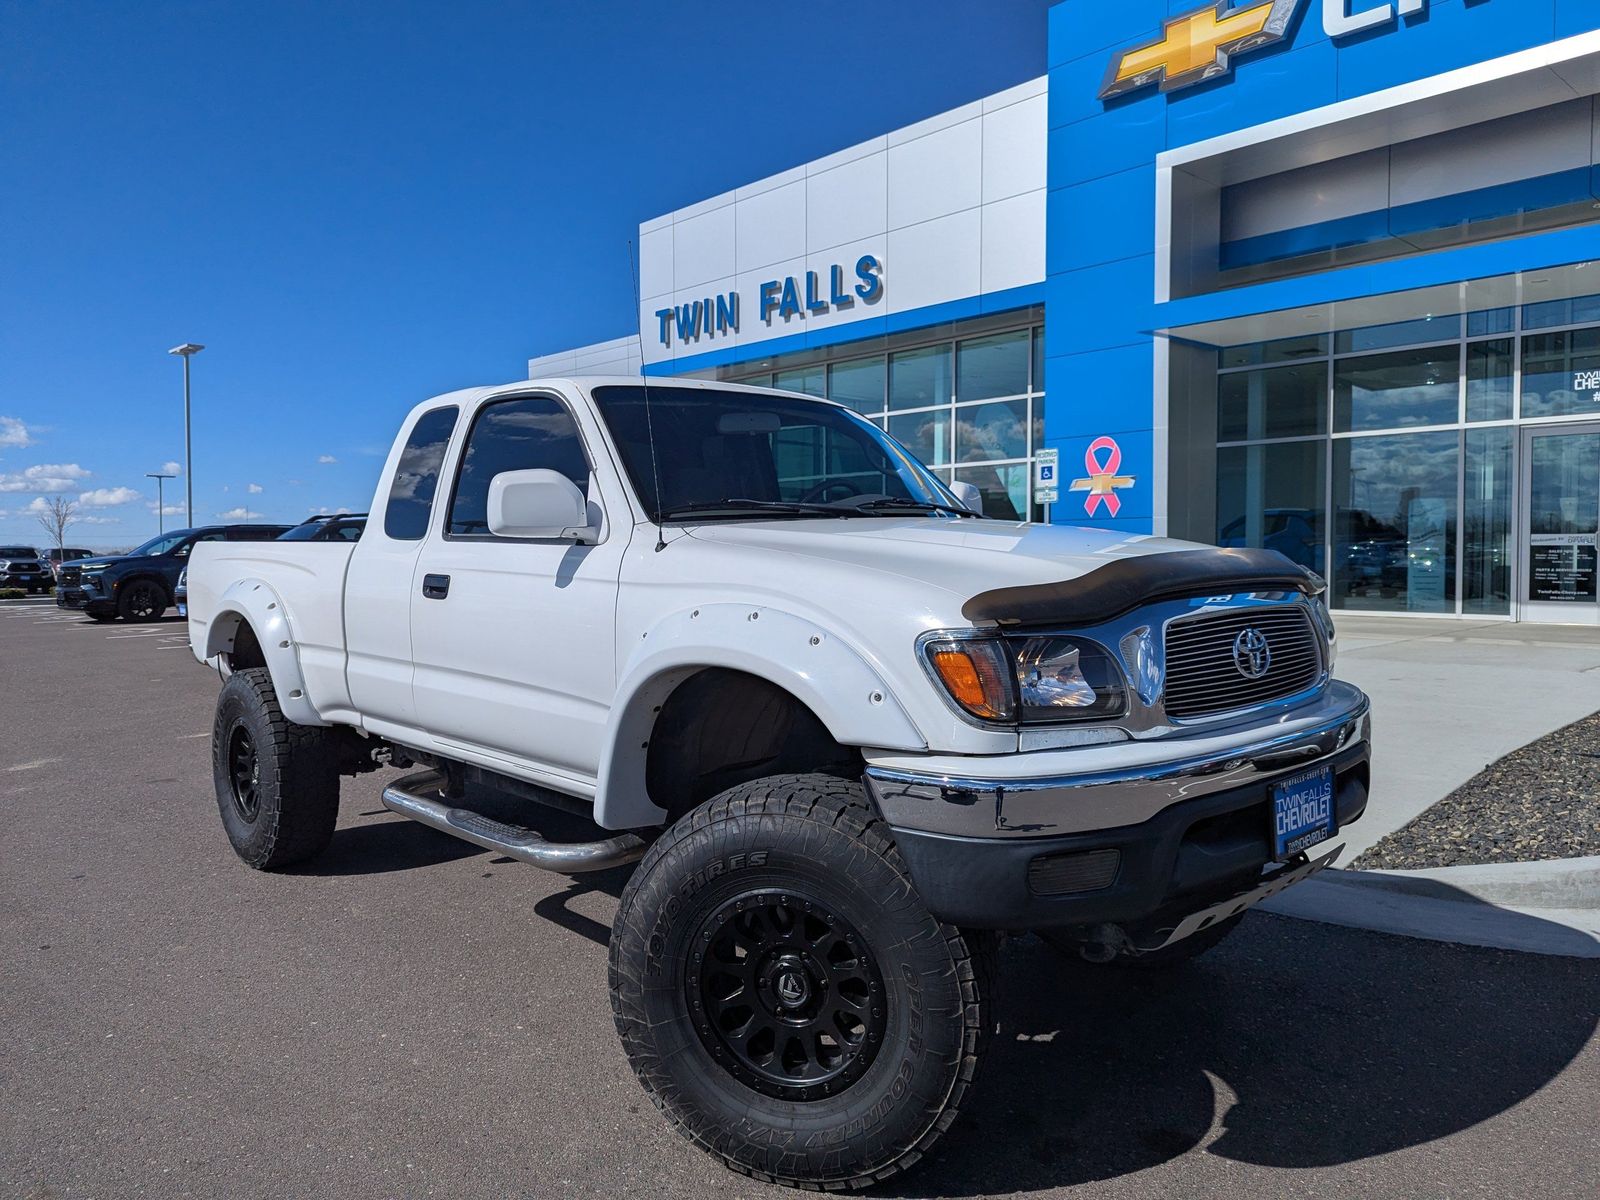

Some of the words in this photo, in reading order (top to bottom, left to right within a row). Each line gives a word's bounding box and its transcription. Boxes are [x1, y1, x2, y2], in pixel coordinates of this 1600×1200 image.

[656, 292, 739, 348] TWIN
[760, 255, 883, 327] FALLS
[1276, 794, 1331, 835] CHEVROLET
[1300, 826, 1329, 850] CHEVROLET
[680, 850, 769, 897] TIRES
[901, 962, 925, 1057] OPEN
[805, 1057, 914, 1149] COUNTRY
